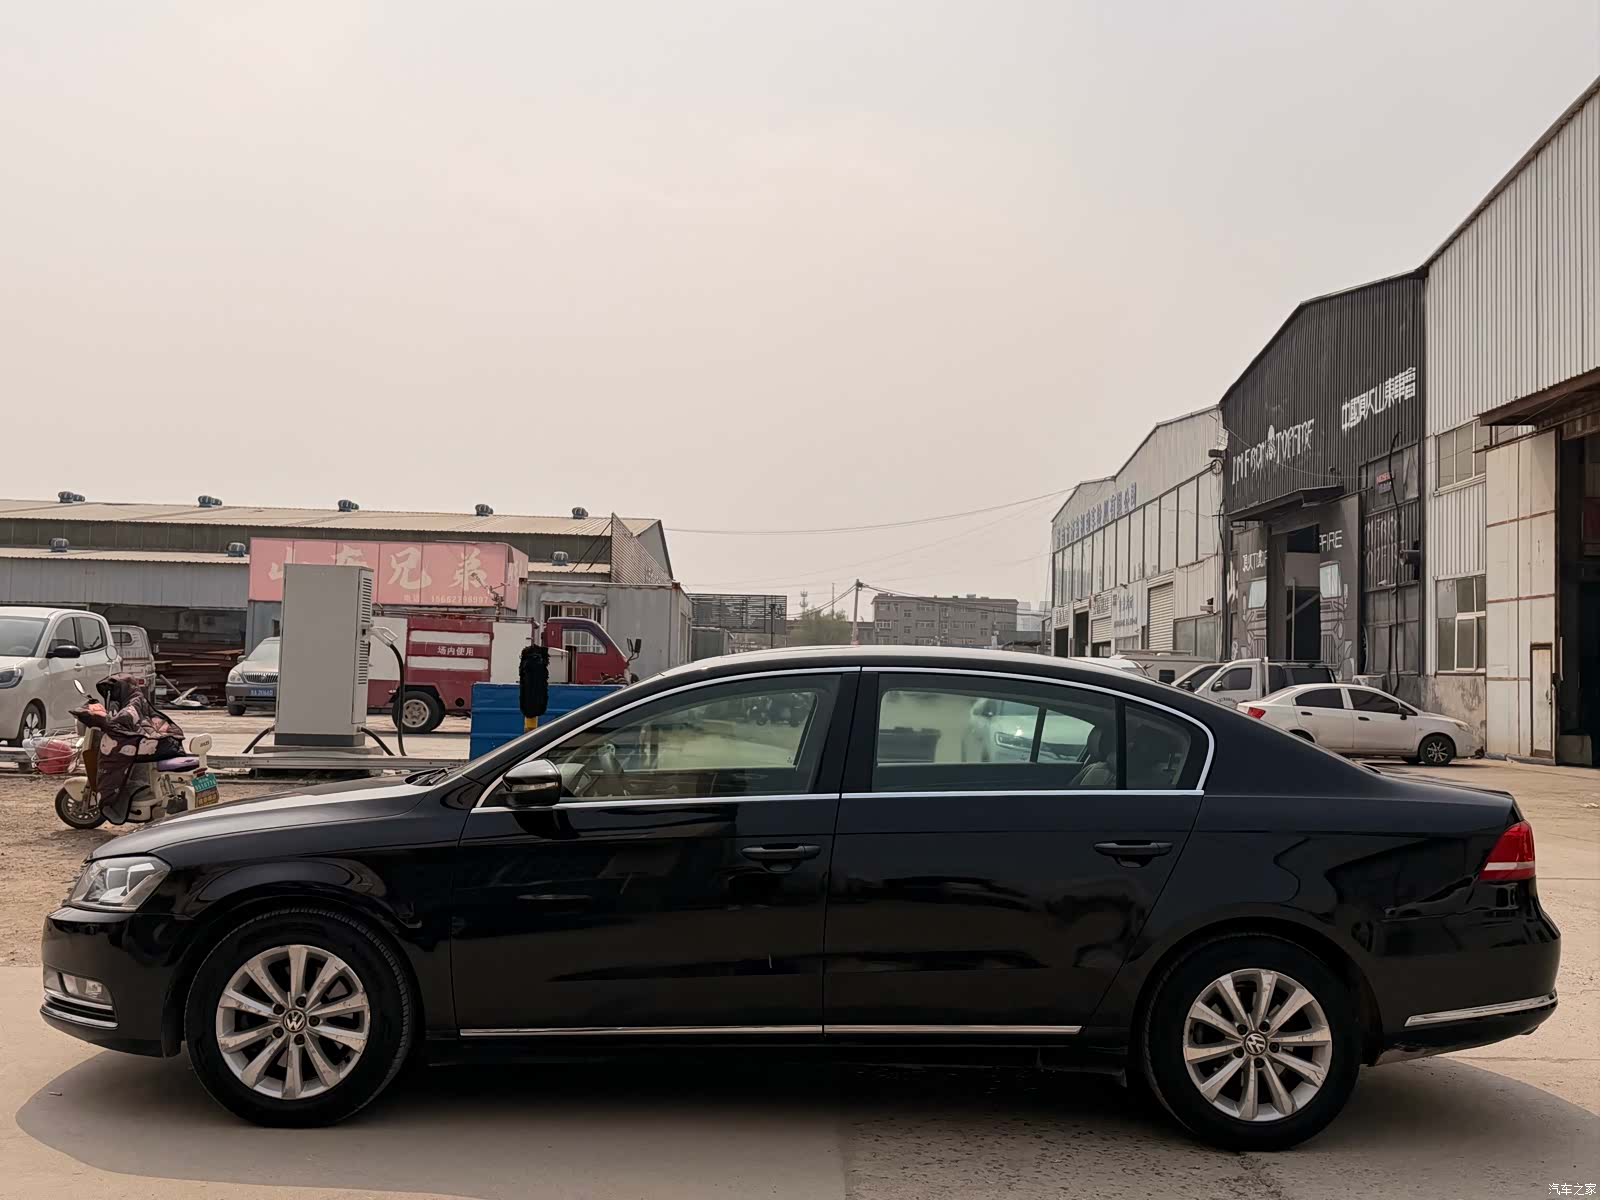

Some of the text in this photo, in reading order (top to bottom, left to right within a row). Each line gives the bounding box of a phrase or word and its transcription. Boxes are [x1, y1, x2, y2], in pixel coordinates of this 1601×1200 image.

[437, 645, 474, 656] 场内使用
[285, 1010, 305, 1031] VW
